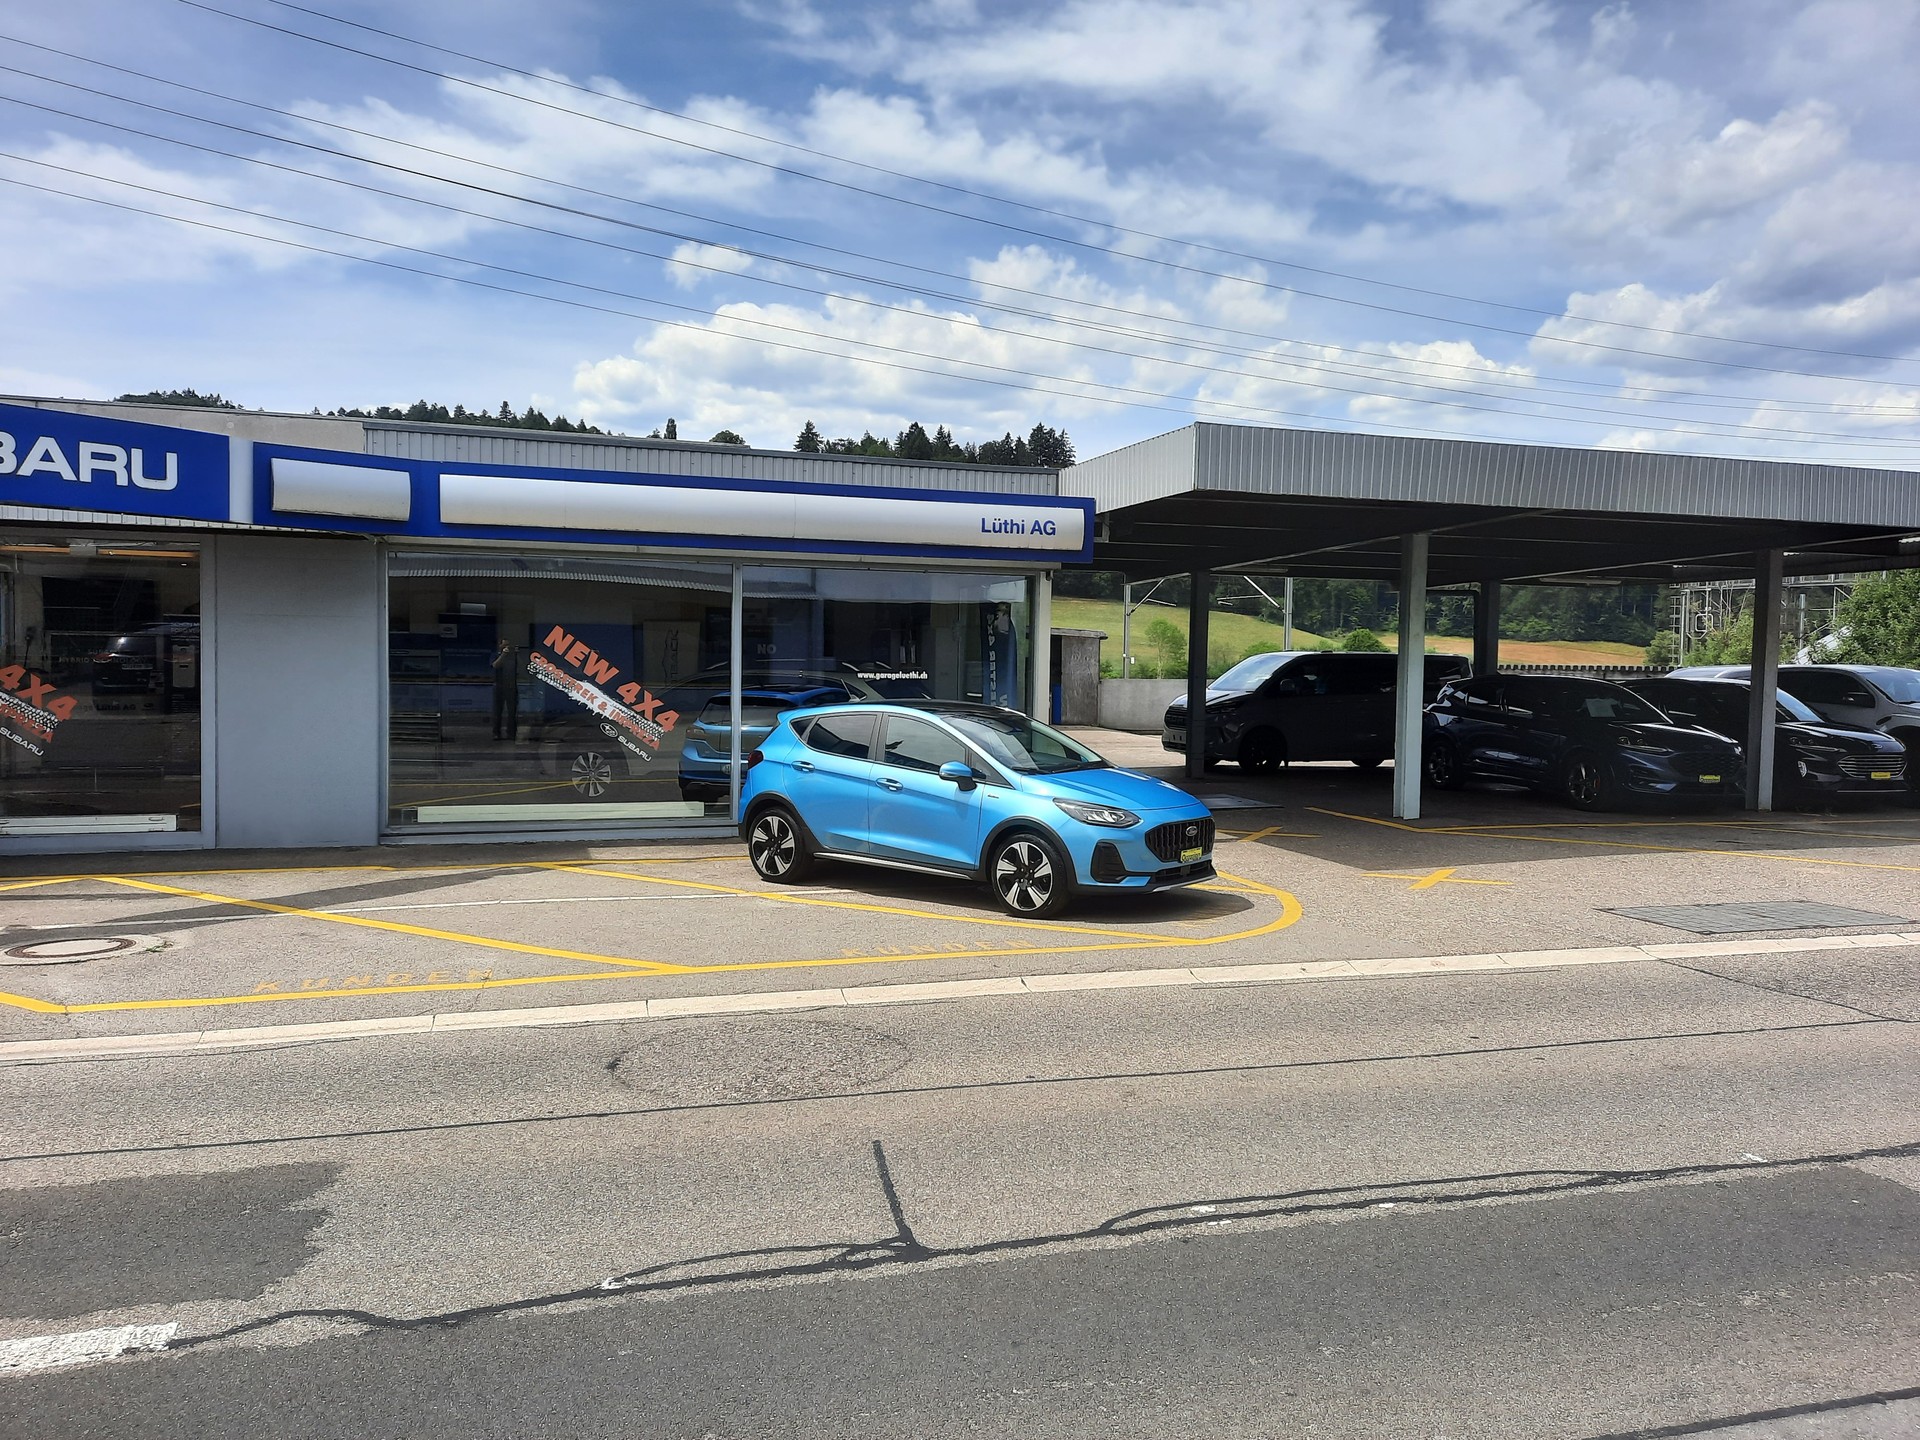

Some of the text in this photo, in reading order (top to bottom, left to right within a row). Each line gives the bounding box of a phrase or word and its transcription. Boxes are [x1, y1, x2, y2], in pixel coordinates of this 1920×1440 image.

[981, 517, 1056, 536] Lüthi AG
[543, 625, 680, 733] NEW 4X4
[857, 670, 928, 681] www.garageluethi.ch
[597, 701, 608, 714] &
[0, 726, 44, 756] SUBARU
[617, 735, 652, 762] SUBARU
[252, 968, 493, 993] KUNDEN
